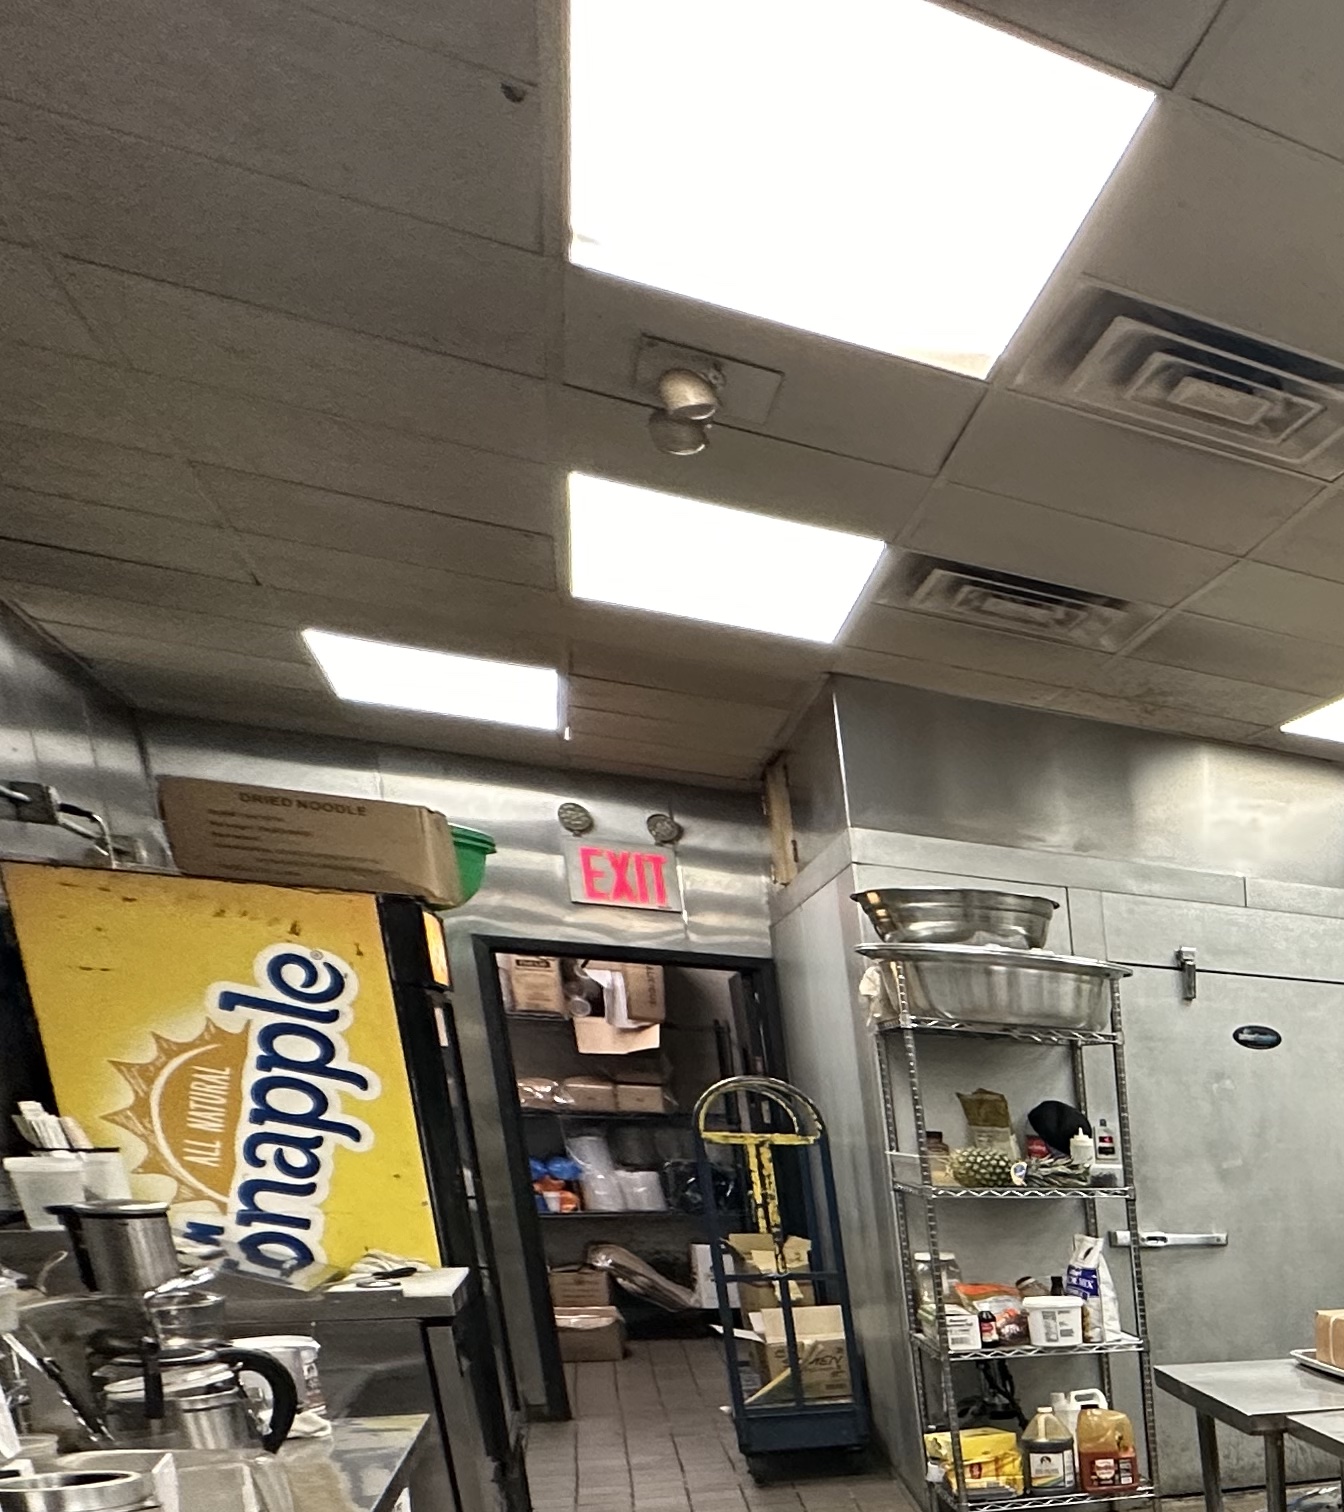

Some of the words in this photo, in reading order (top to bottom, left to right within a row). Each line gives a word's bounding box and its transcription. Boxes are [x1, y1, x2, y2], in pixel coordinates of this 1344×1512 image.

[239, 791, 293, 809] DRIED
[297, 799, 367, 818] NOODLE
[579, 847, 667, 908] EXIT
[186, 1066, 232, 1133] NATURAL
[182, 1139, 223, 1168] ALL
